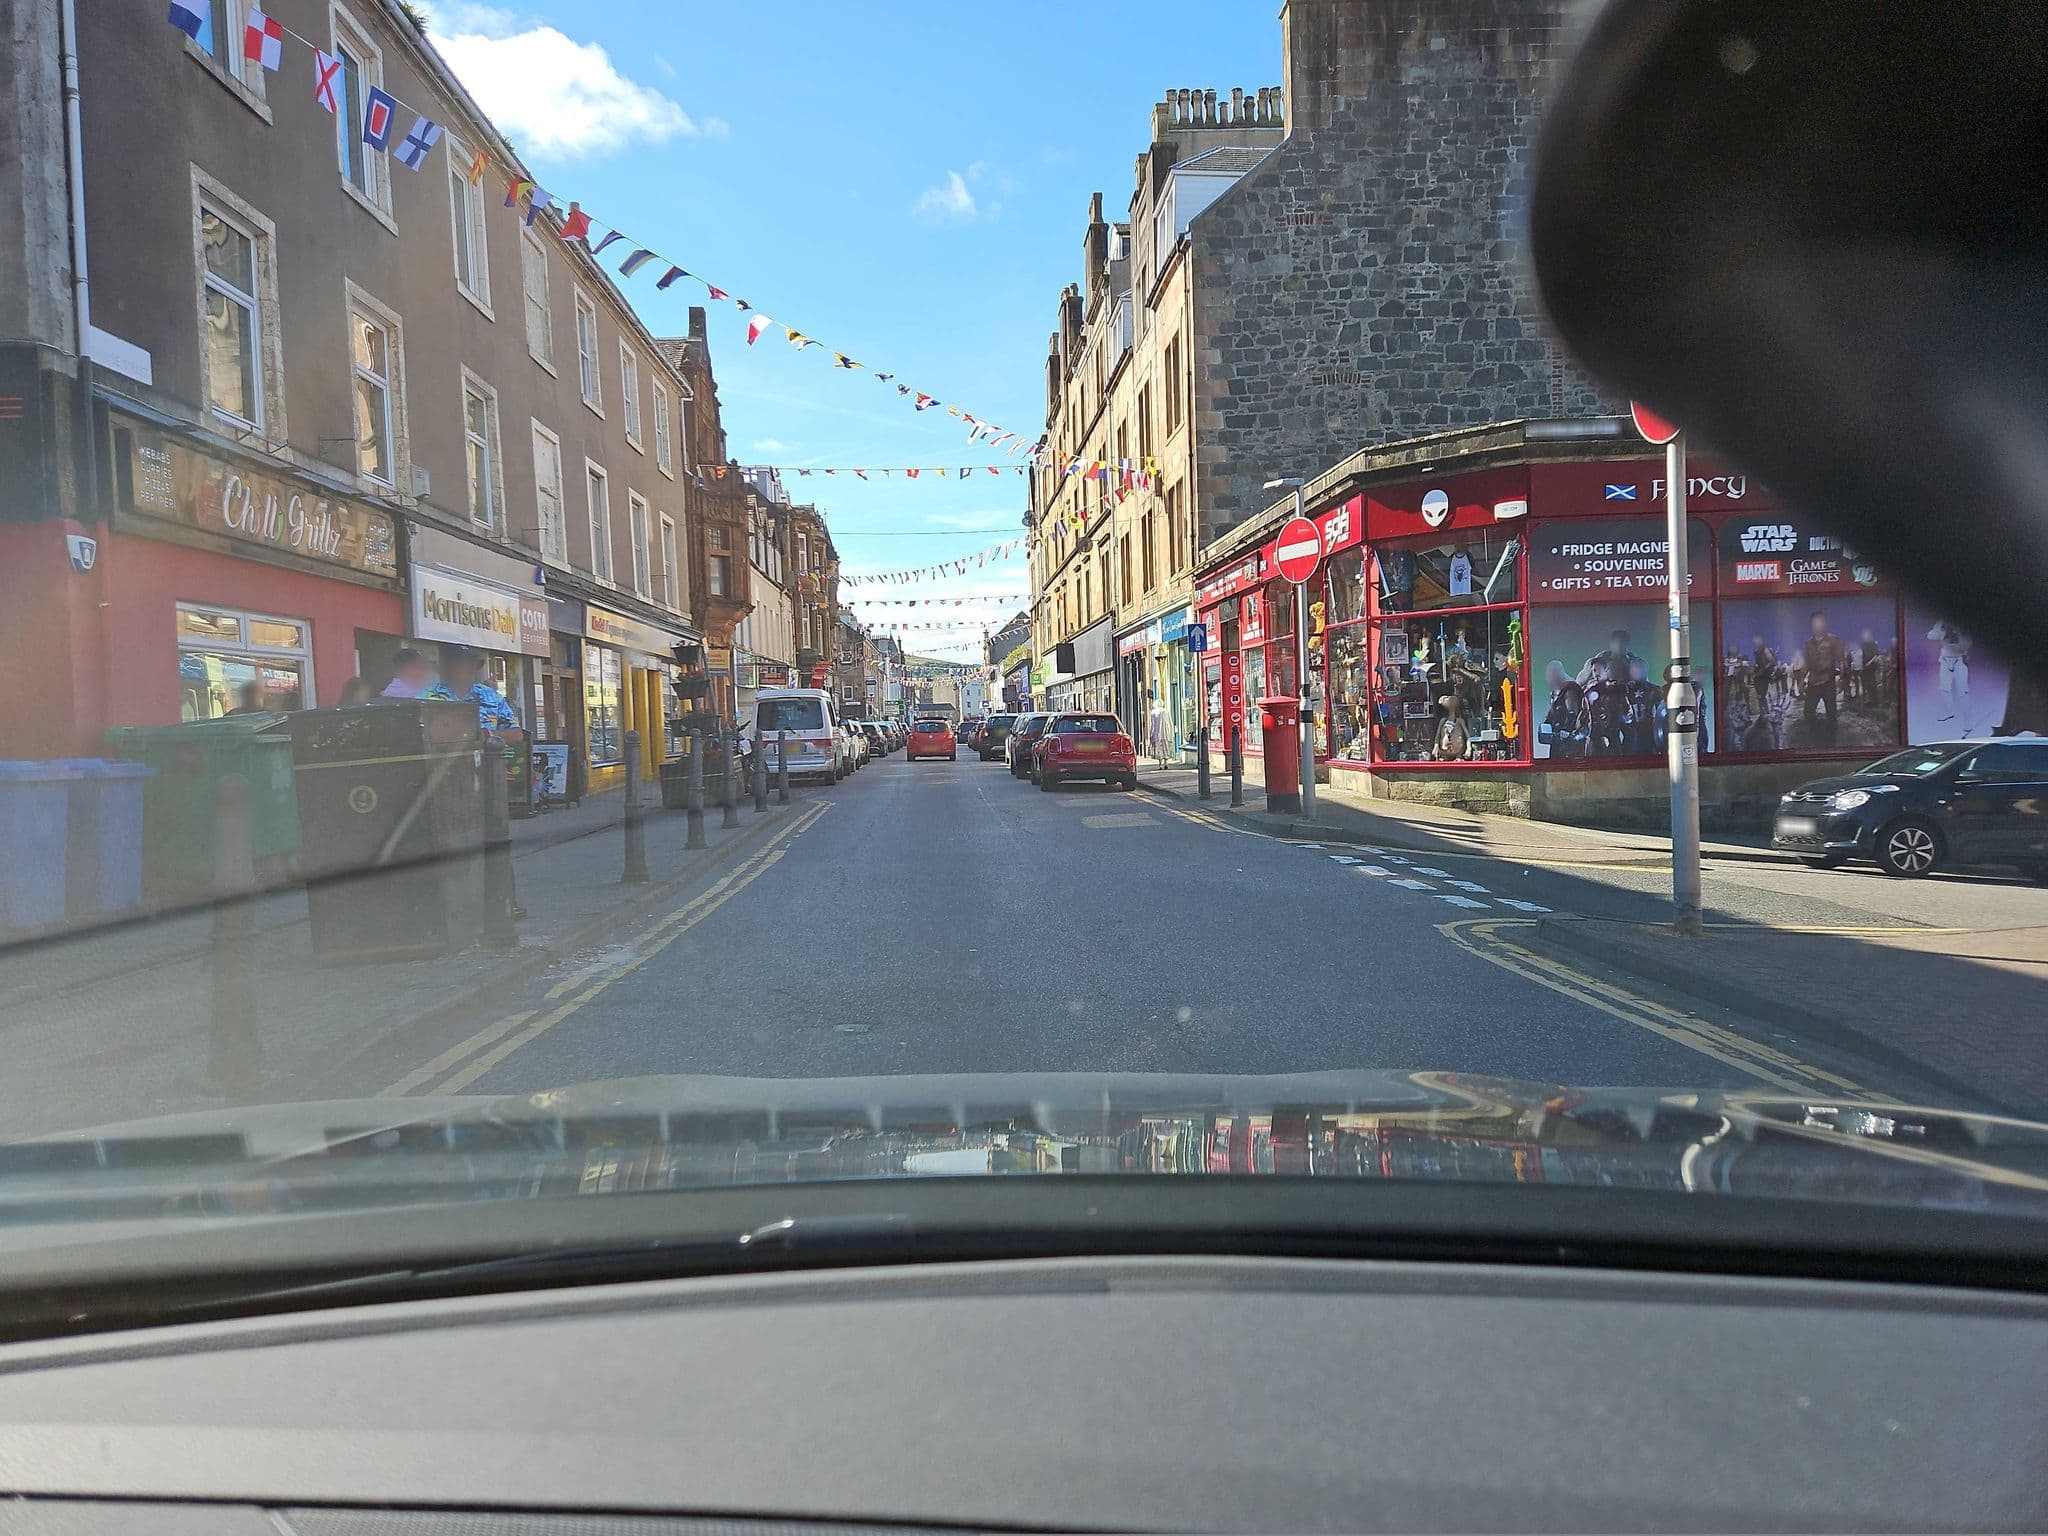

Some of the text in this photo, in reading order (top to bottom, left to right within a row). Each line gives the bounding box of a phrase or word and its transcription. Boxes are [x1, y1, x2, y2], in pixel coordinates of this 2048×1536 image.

[1649, 475, 1747, 503] FNCY
[288, 495, 342, 558] Grillz
[1740, 525, 1797, 539] STAR
[1562, 541, 1670, 556] FRIDGE MAGNE
[1740, 538, 1798, 553] WARS
[1584, 558, 1665, 572] SOUVENIRS
[1736, 563, 1781, 582] MARVEL
[1790, 559, 1828, 573] GAME
[1551, 573, 1693, 590] GIFTS TEA TOWS
[1785, 571, 1841, 586] THRONES
[423, 588, 517, 643] Morrisons Daily
[521, 607, 548, 631] COSTA
